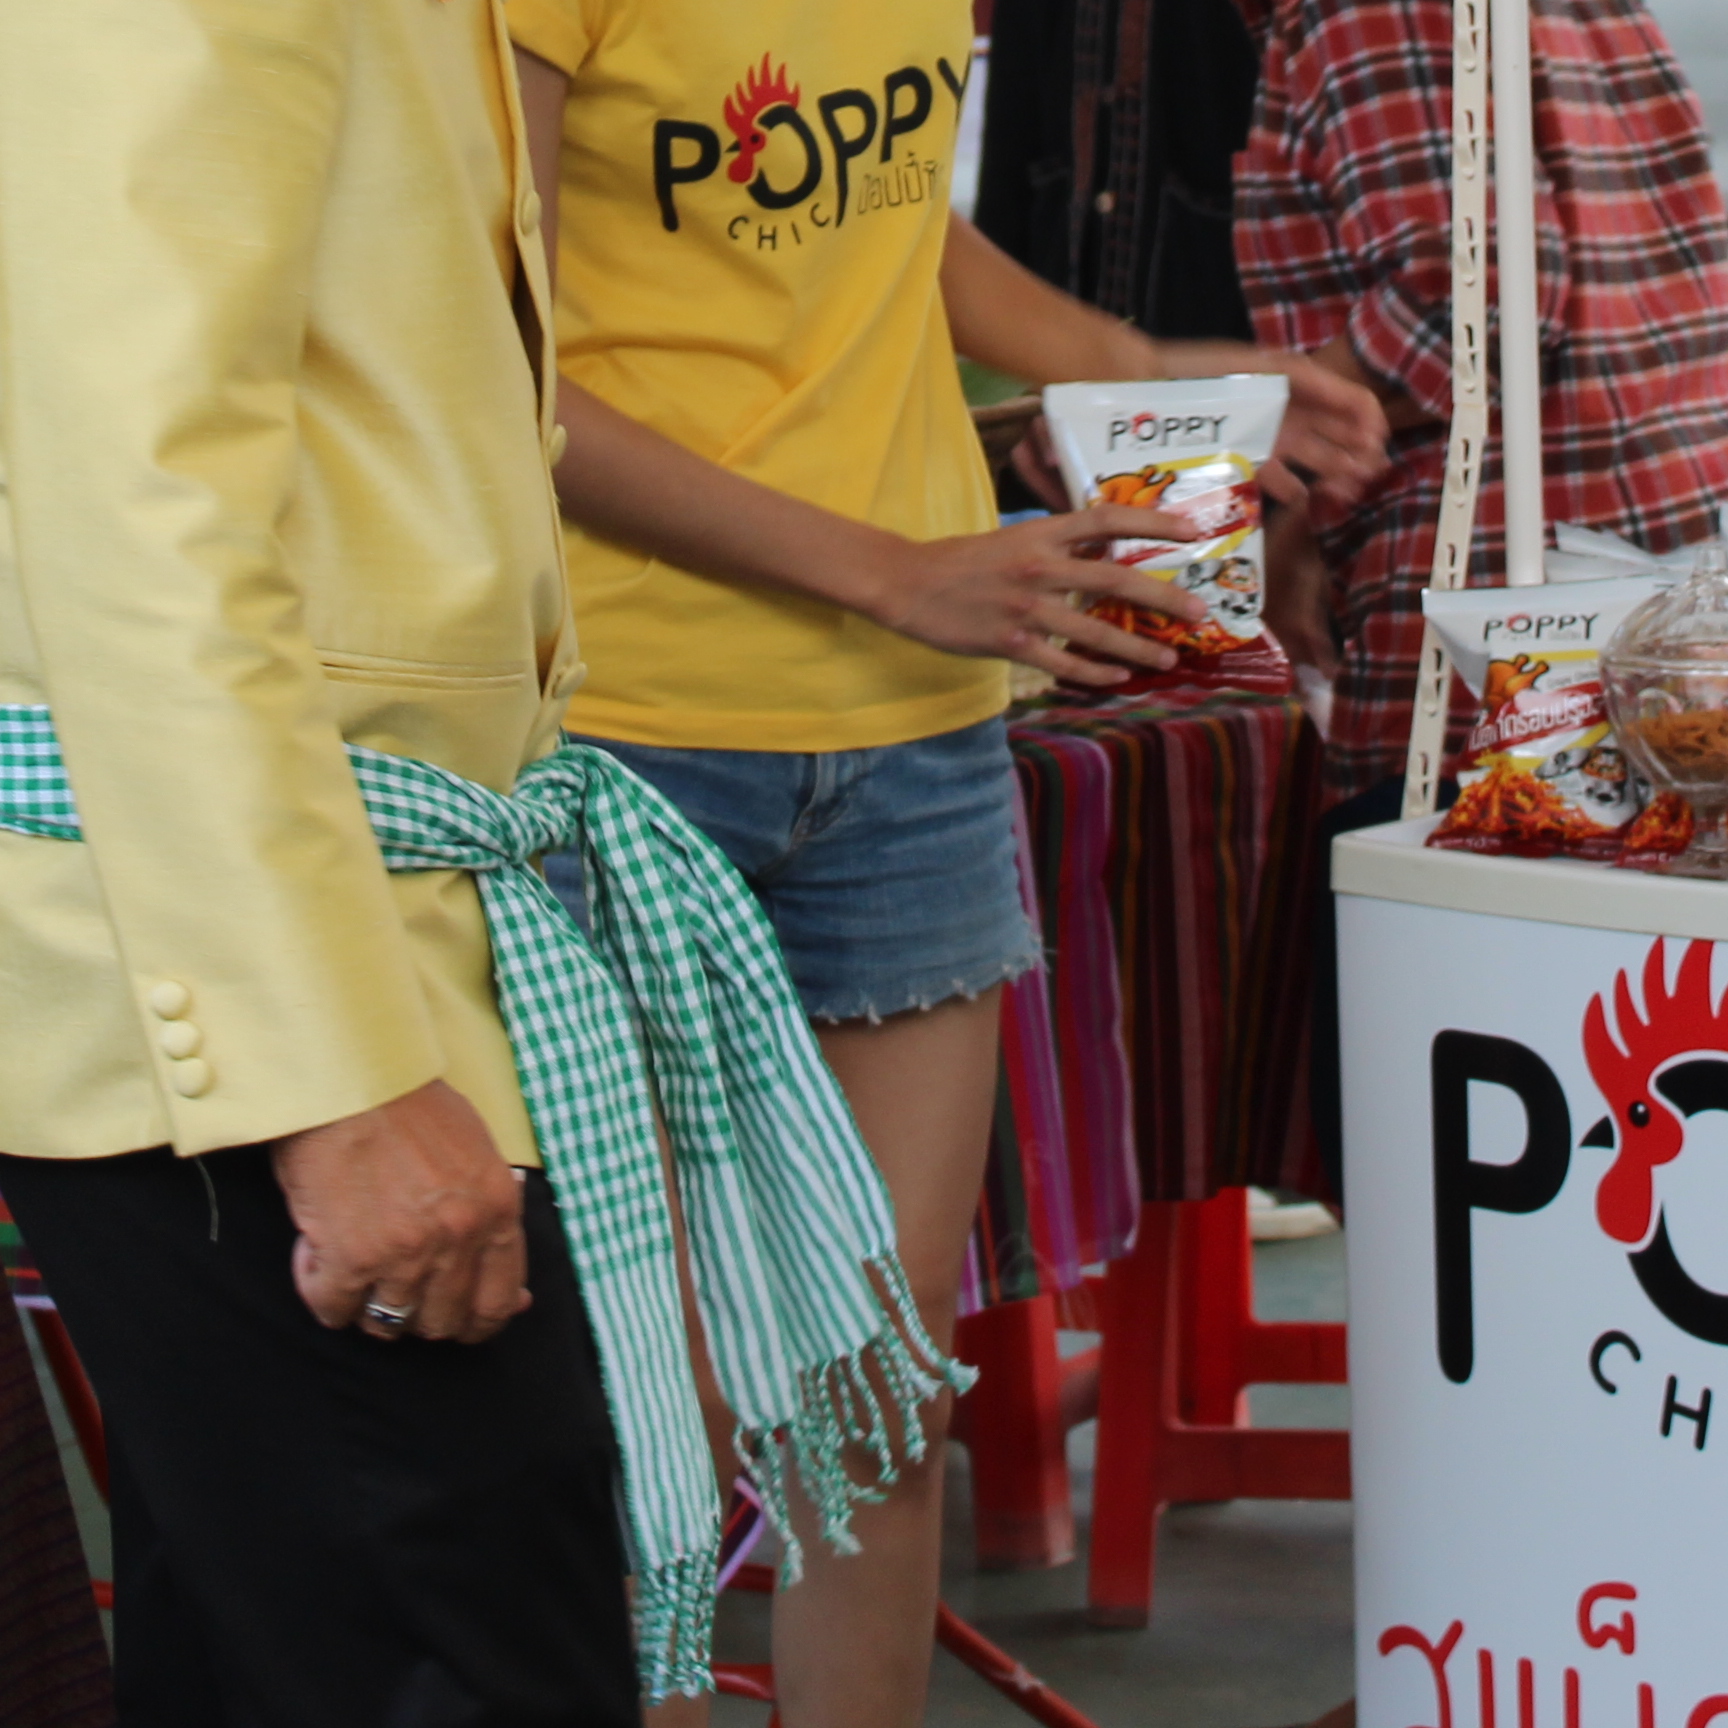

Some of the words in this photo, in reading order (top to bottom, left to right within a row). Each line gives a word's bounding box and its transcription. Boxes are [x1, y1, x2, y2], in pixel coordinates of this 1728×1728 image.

[653, 50, 971, 232] POPPY
[728, 202, 831, 250] CHIC
[1107, 414, 1230, 452] POPPY
[1483, 613, 1600, 643] POPPY
